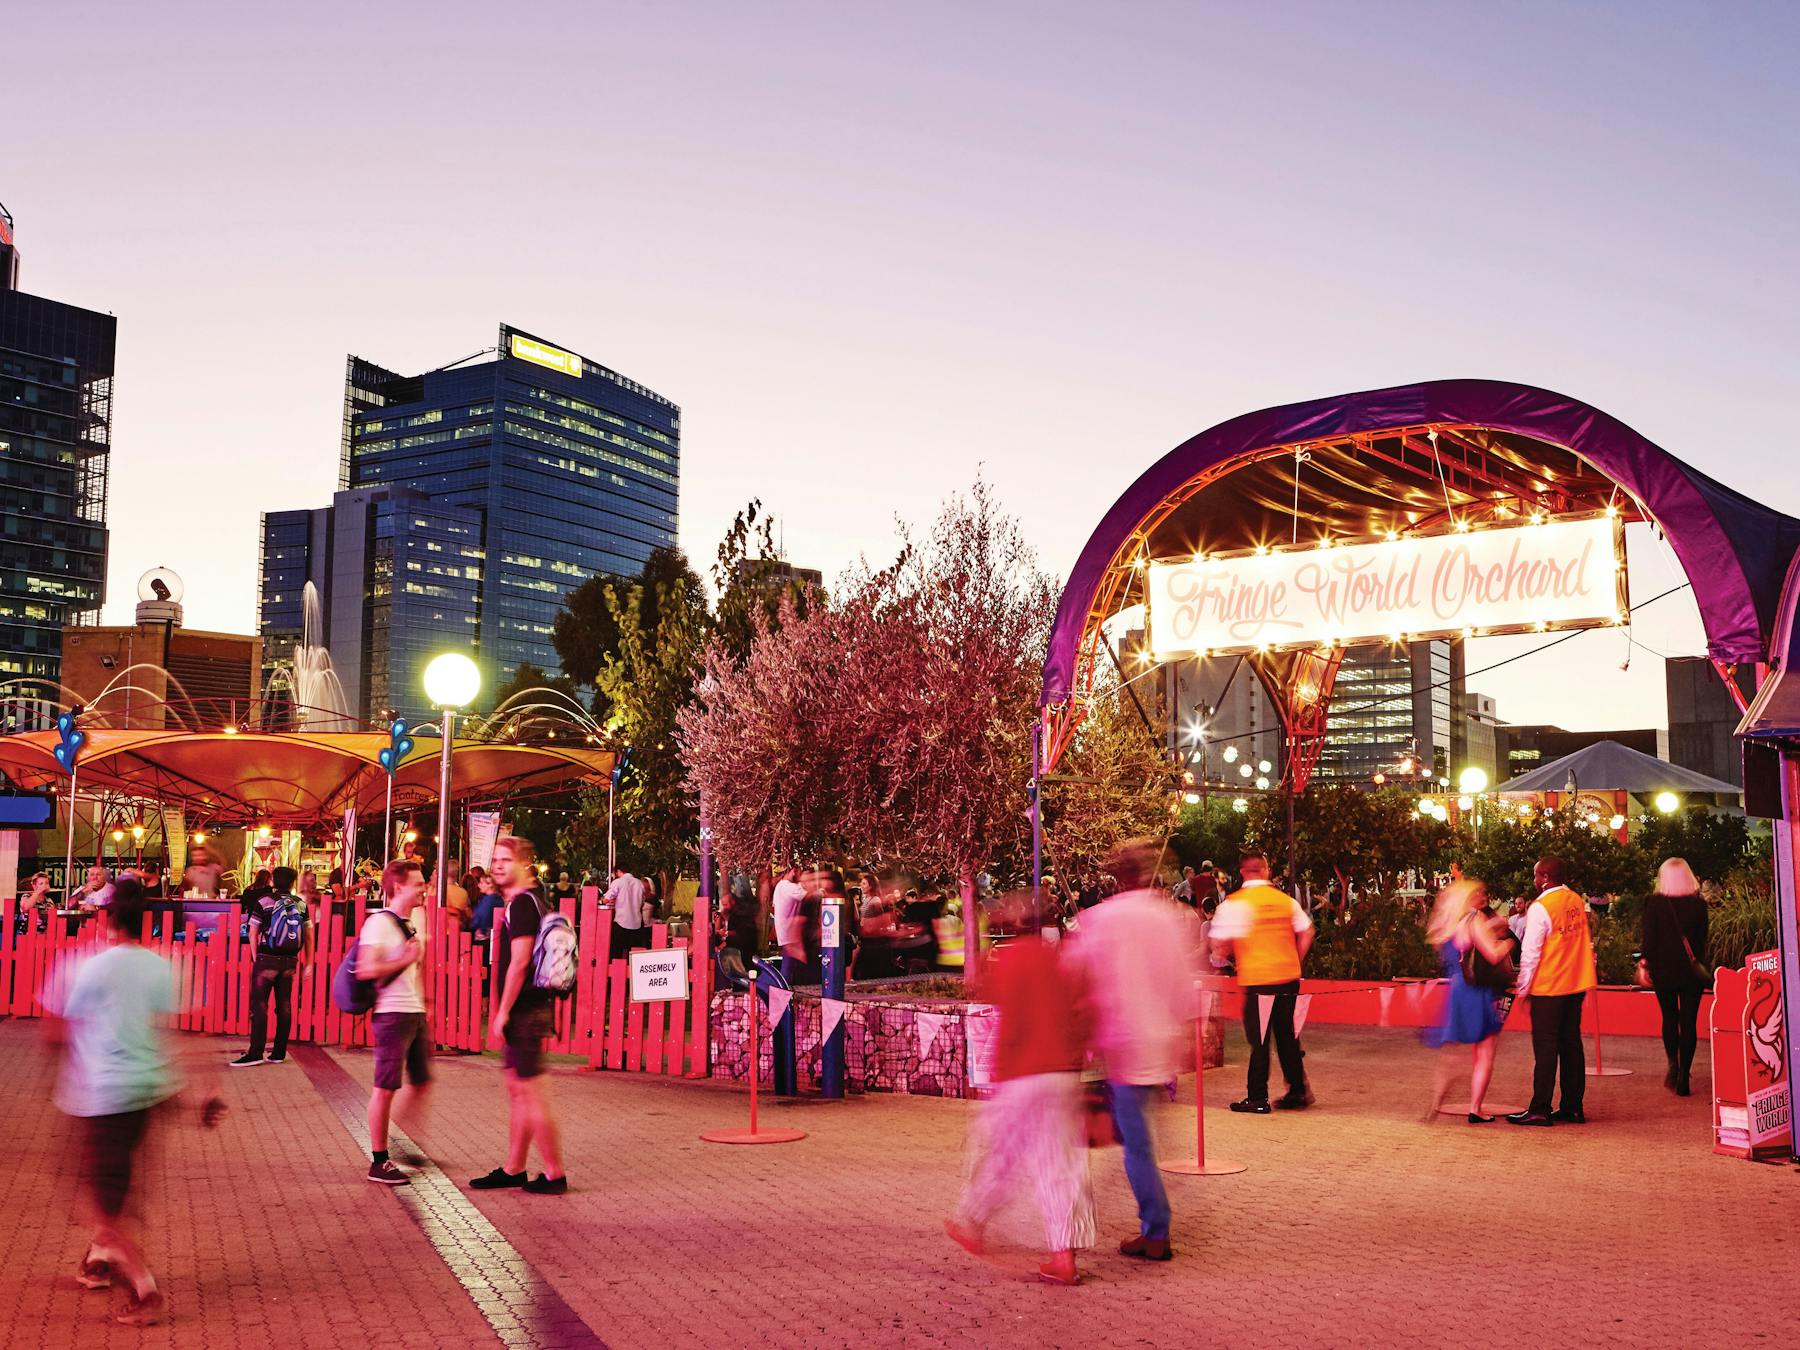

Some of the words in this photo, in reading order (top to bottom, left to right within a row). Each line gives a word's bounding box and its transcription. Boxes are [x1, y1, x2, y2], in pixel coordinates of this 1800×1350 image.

[1168, 567, 1304, 641] Fringe
[1294, 553, 1420, 625] World
[1431, 537, 1594, 621] Orchard
[640, 963, 676, 973] ASSEMBLY
[1752, 957, 1778, 972] FRINGE
[648, 977, 668, 987] AREA
[1753, 1090, 1789, 1117] FRINGE
[1756, 1108, 1789, 1134] WORLD
